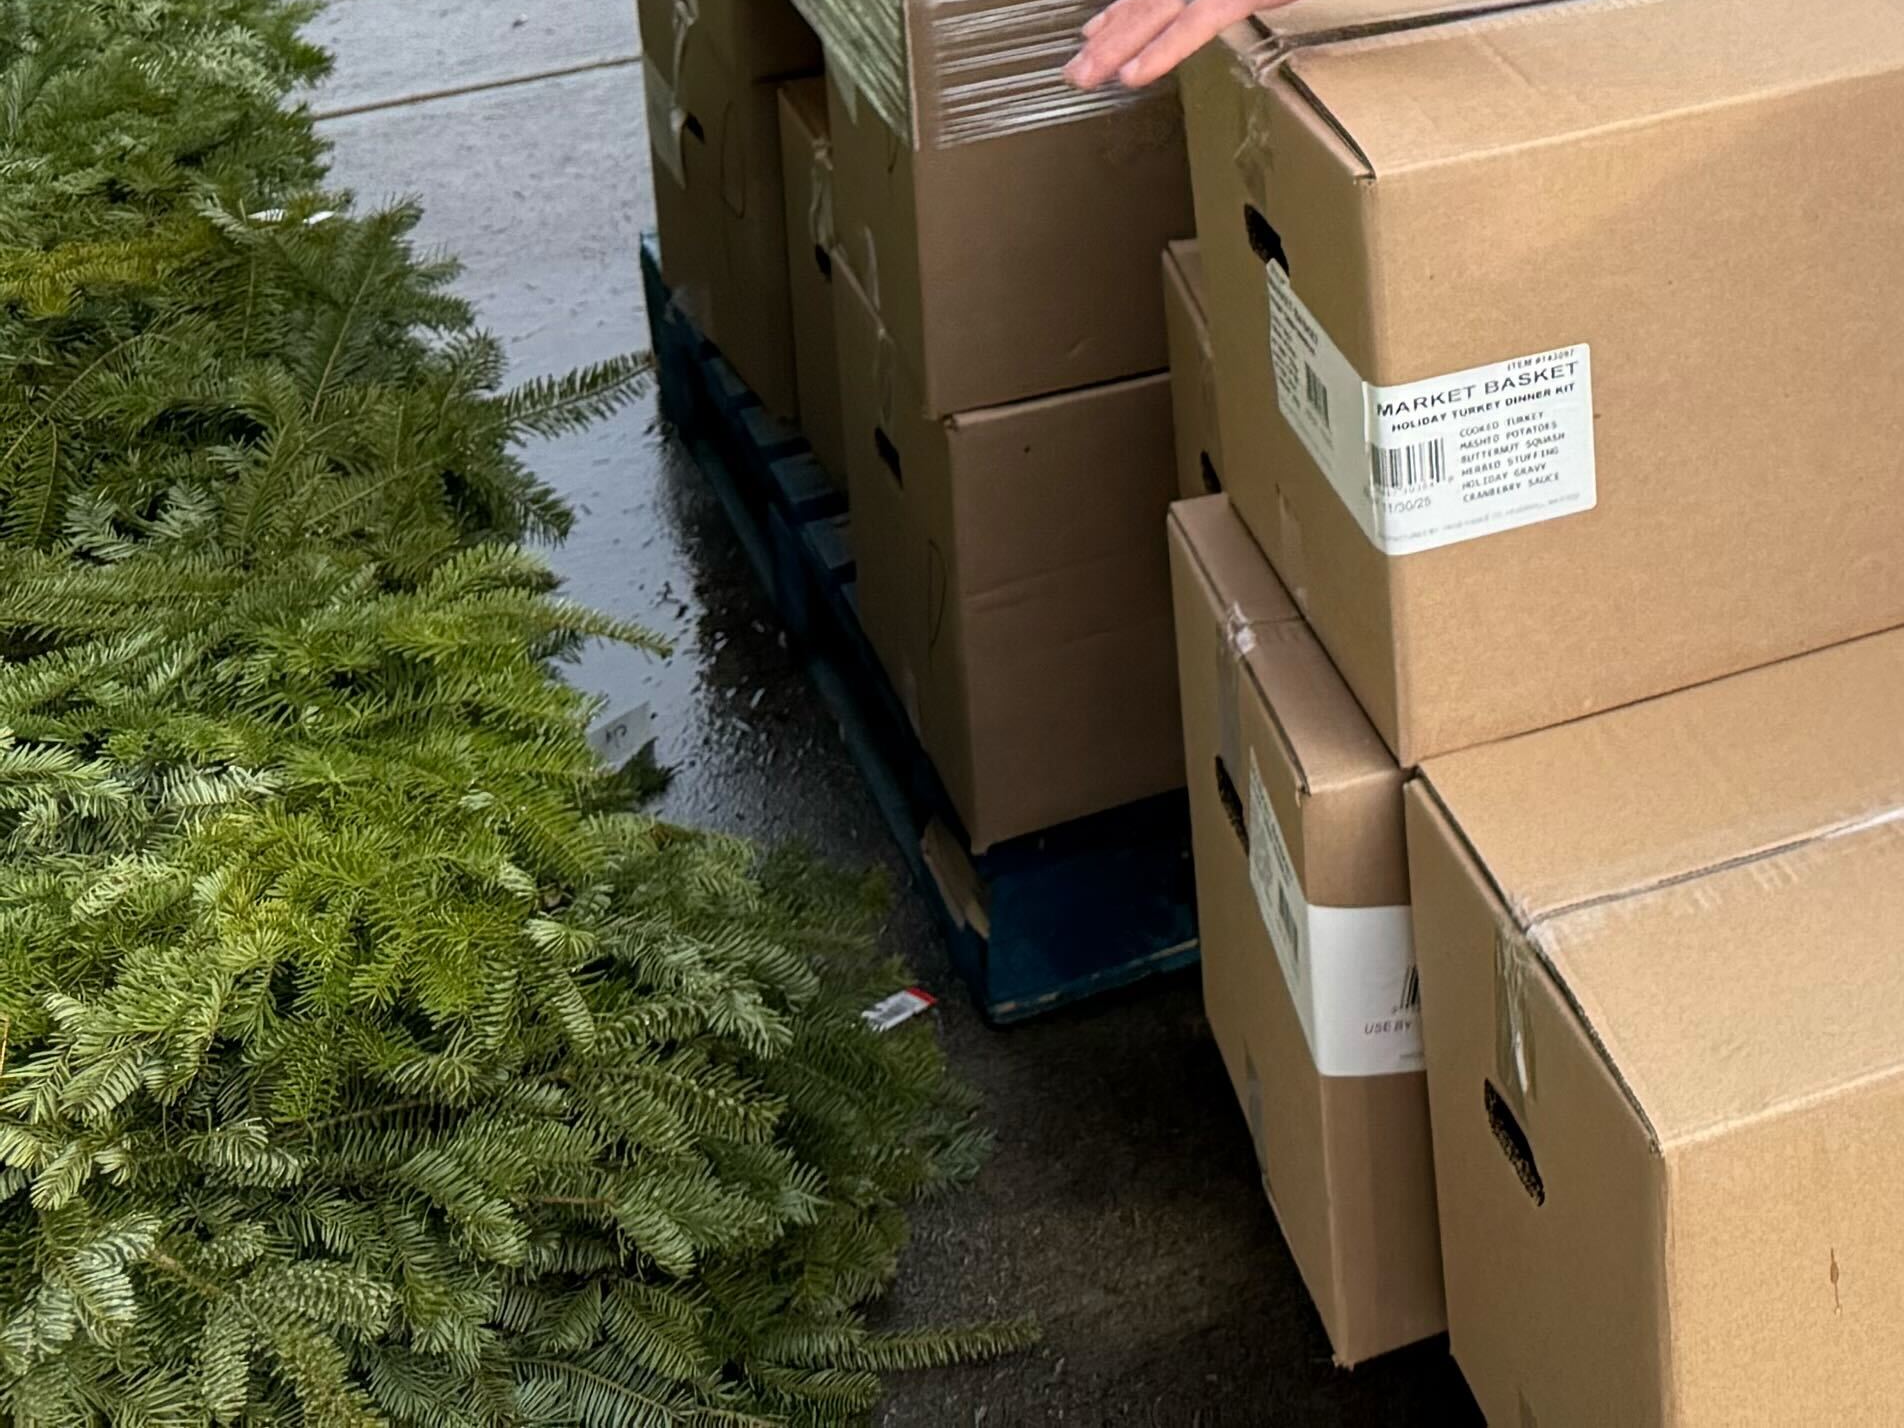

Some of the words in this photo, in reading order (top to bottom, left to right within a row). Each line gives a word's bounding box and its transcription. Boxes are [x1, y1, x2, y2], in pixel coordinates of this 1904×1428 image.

[1376, 384, 1477, 417] MARKET
[1484, 361, 1579, 394] BASKET
[1391, 412, 1447, 432] HOLIDAY
[1452, 400, 1501, 420] TURKEY
[1505, 387, 1551, 407] DINNER
[1555, 382, 1576, 394] KIT
[1459, 421, 1499, 438] COOKED
[1506, 411, 1544, 427] TURKEY
[1459, 433, 1500, 450] MASHED
[1505, 421, 1557, 441] POTATOES
[1460, 443, 1519, 464] BUTTERNUT
[1526, 432, 1566, 449] SQUASH
[1507, 446, 1559, 466] STUFFING
[1462, 472, 1508, 490] HOLIDAY
[1514, 462, 1547, 478] GRAVY
[1463, 482, 1522, 503] CRANBERRY
[1528, 472, 1560, 488] SAUCE
